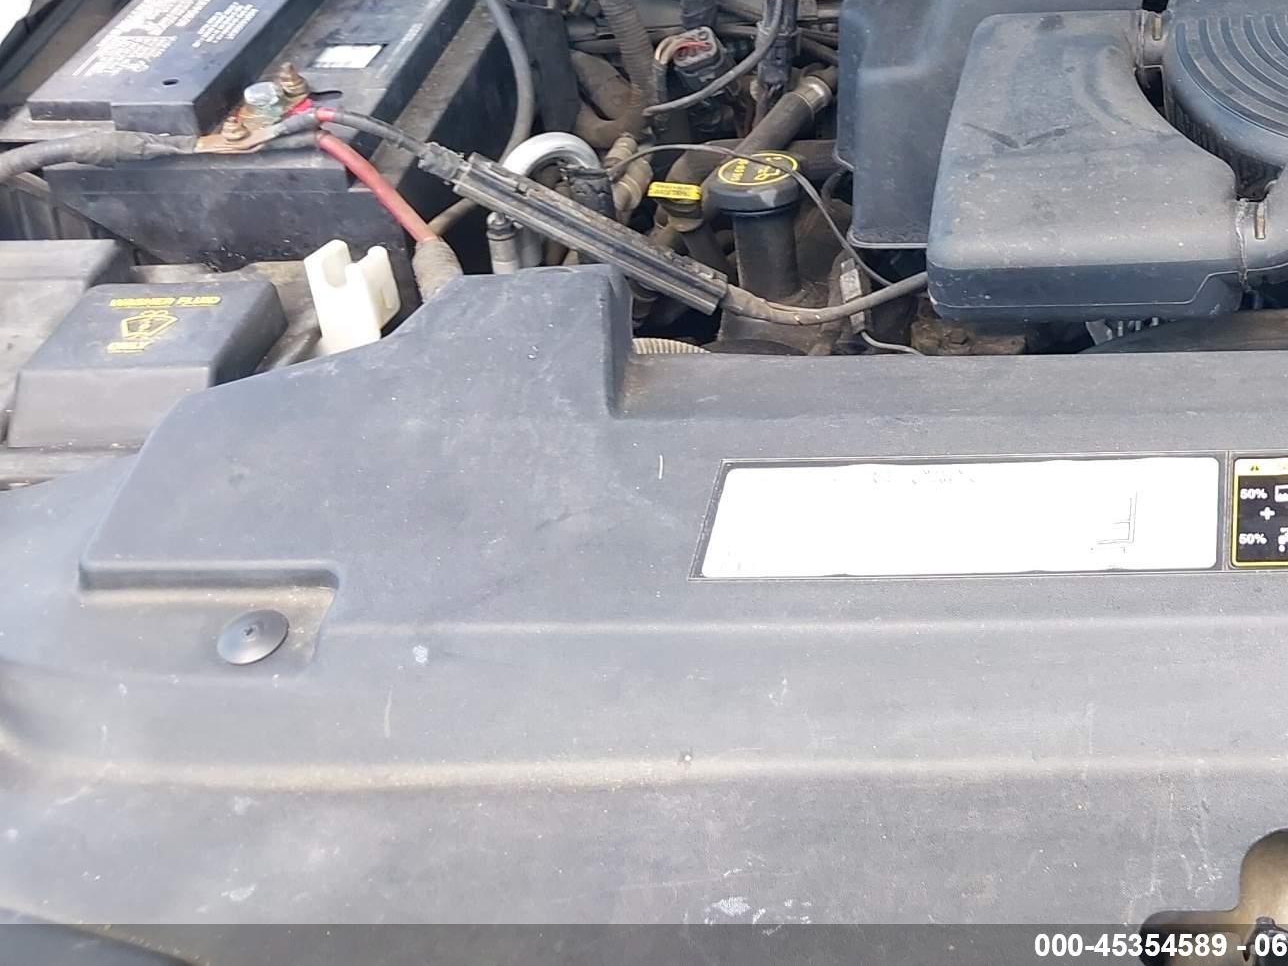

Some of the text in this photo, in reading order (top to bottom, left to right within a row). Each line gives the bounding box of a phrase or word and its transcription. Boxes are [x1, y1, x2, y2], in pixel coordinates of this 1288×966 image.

[176, 297, 222, 306] FLUID
[1240, 489, 1267, 499] 50%
[1239, 534, 1267, 544] 50%
